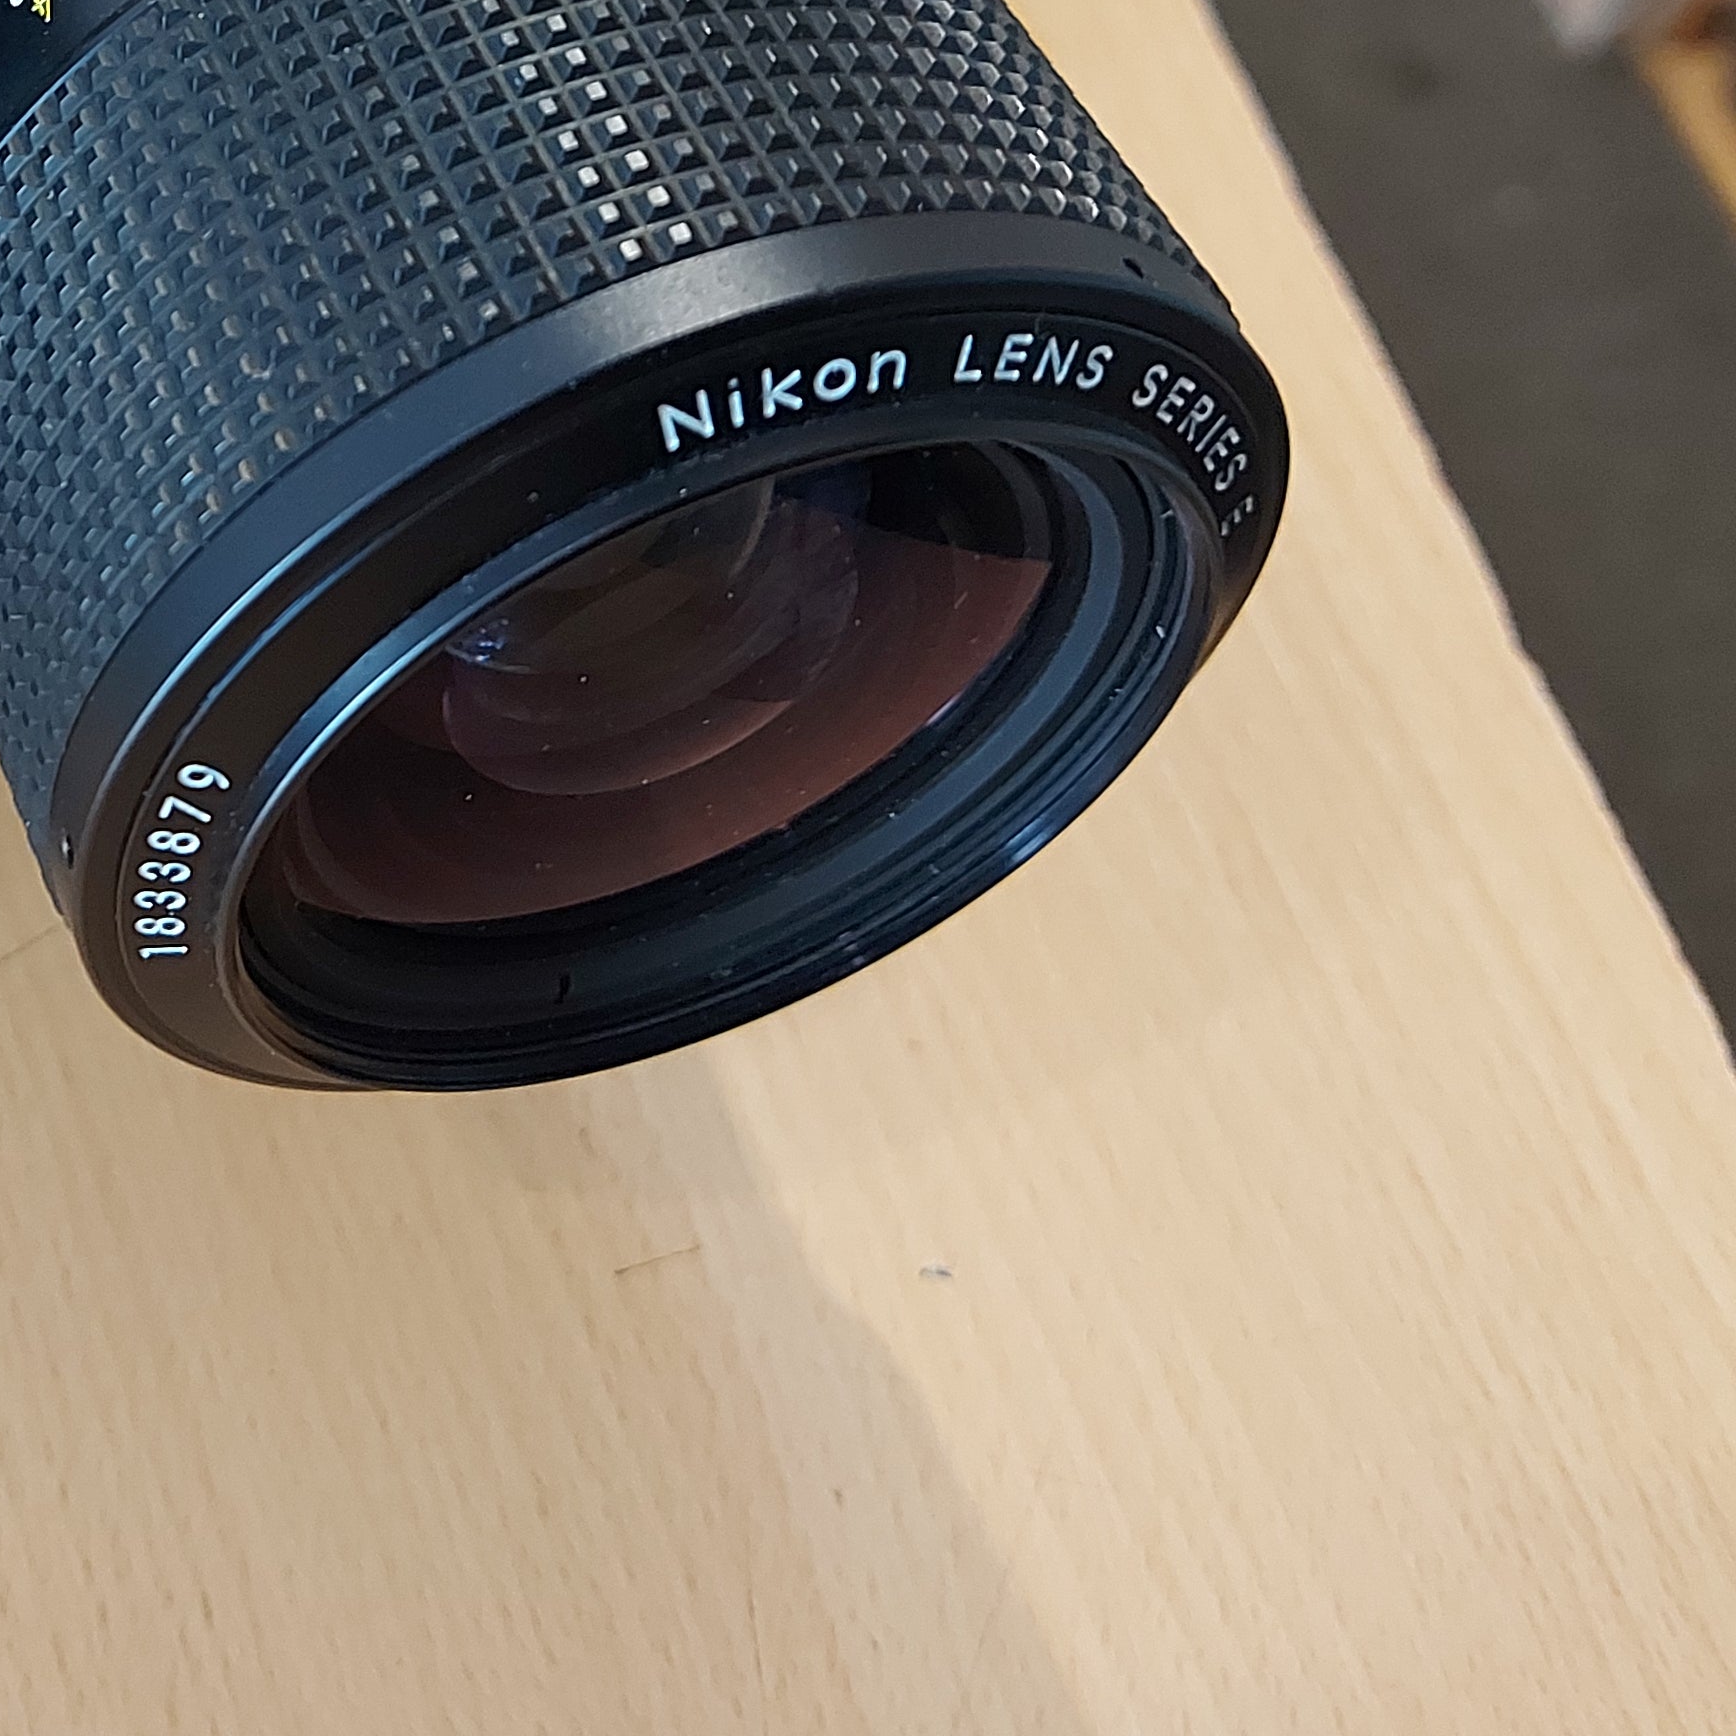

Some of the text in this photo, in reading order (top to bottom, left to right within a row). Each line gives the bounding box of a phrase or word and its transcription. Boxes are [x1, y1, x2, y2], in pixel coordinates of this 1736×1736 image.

[657, 333, 1254, 537] Nikon LENS SERIES E
[133, 764, 230, 959] 1833879
